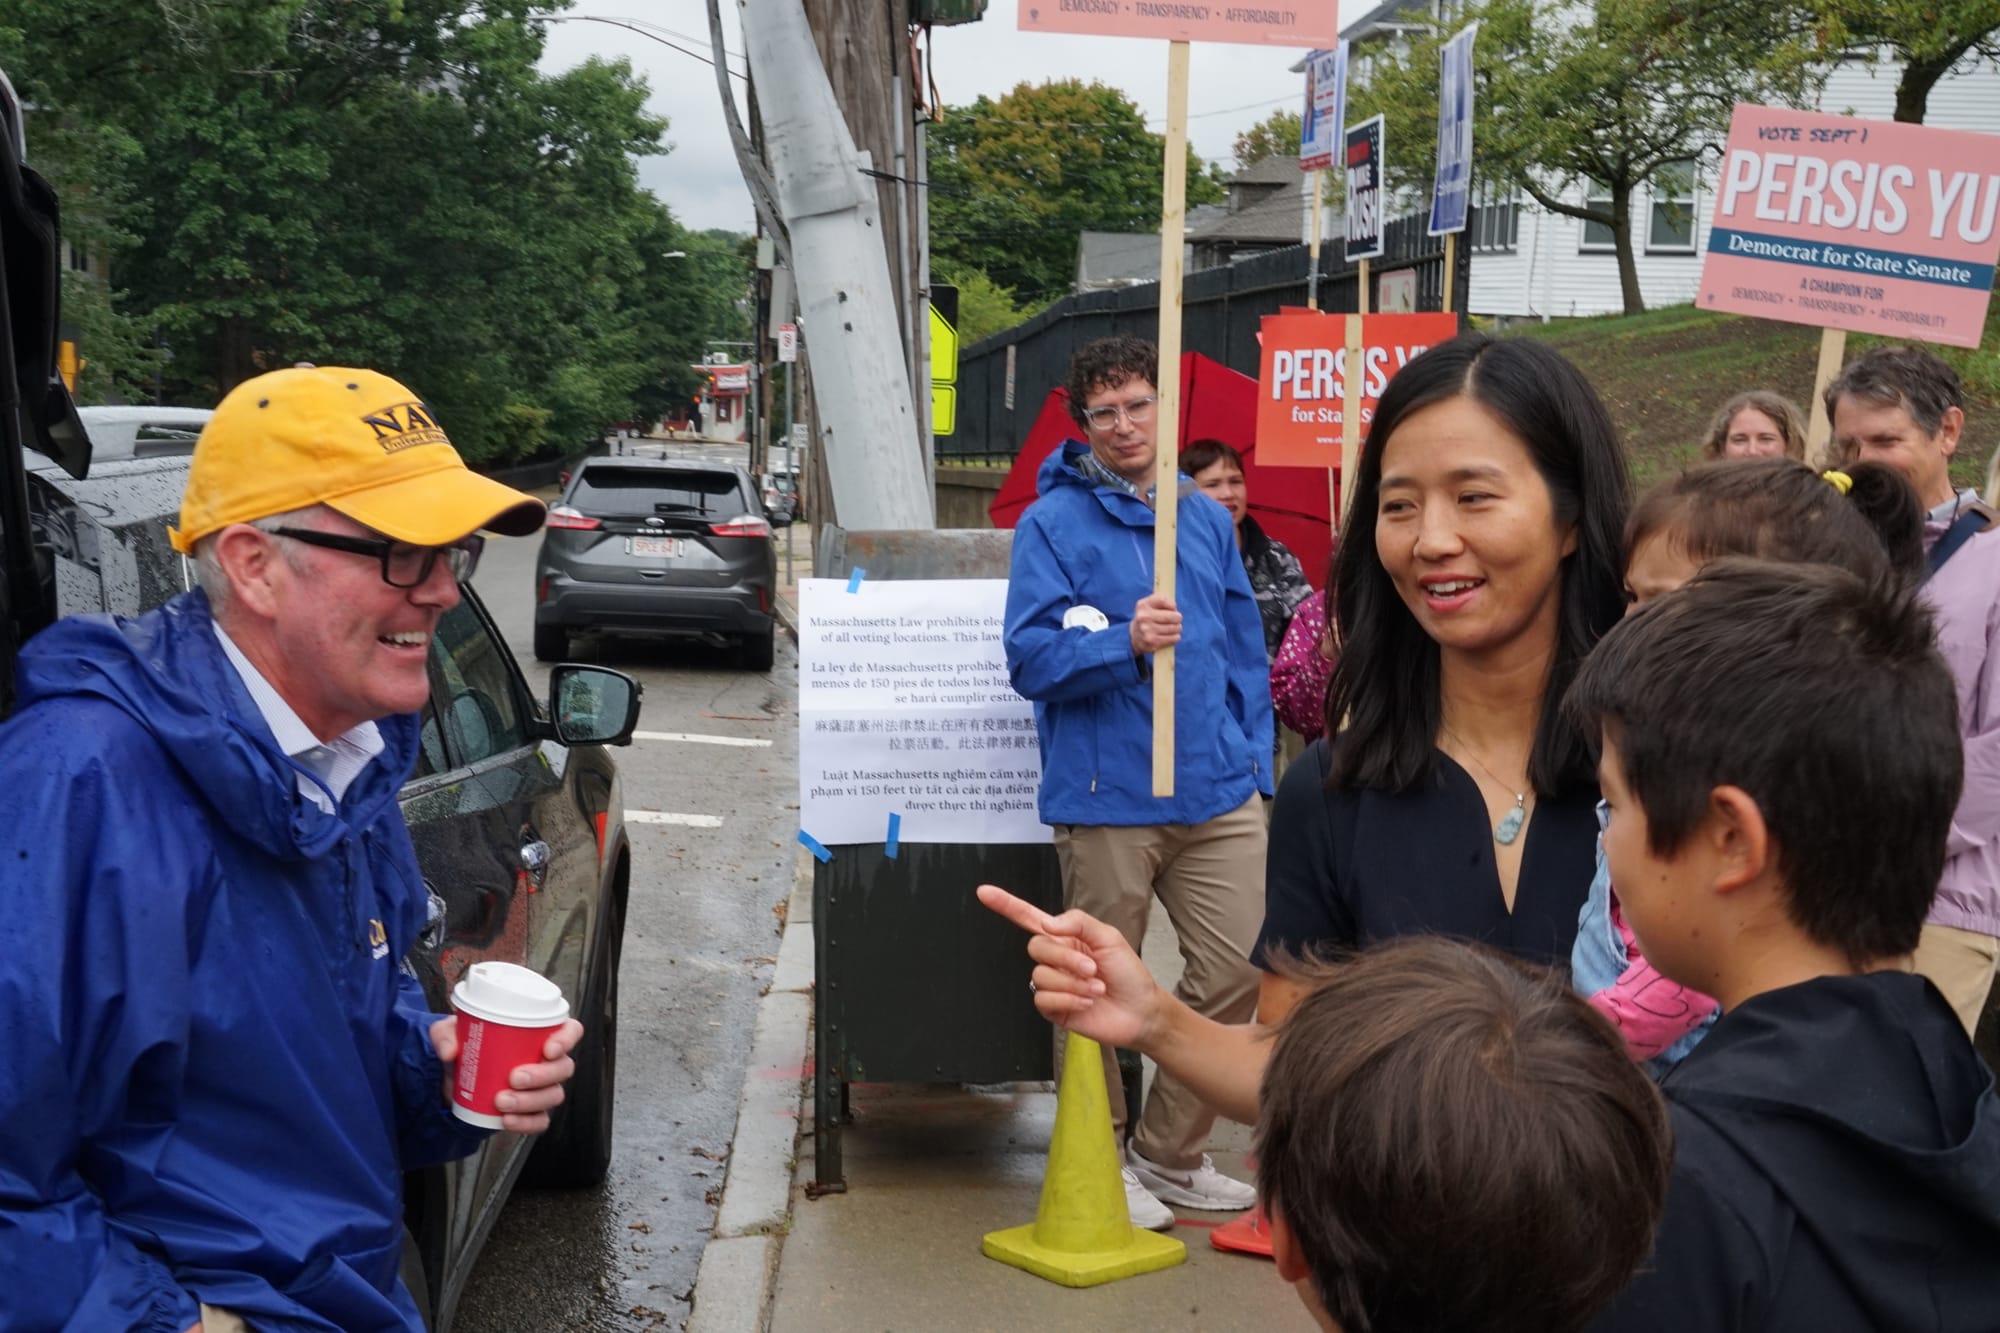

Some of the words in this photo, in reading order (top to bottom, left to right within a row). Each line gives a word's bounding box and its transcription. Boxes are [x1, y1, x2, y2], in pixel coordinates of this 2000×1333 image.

[1059, 0, 1119, 14] DEMOCRACY
[1136, 2, 1211, 21] TRANSPARENCY
[1225, 9, 1297, 25] AFFORDABILITY
[1758, 126, 1802, 141] VOTE
[1810, 128, 1857, 143] SEPT
[1721, 149, 1915, 235] PERSIS
[1928, 168, 2000, 243] YU
[1728, 233, 1819, 264] Democrat
[1823, 247, 1852, 266] for
[1853, 251, 1902, 274] State
[1905, 261, 1972, 283] Senate
[1800, 277, 1808, 290] A
[1809, 279, 1862, 298] CHAMPION
[1864, 287, 1884, 301] FOR
[1731, 287, 1784, 304] DEMOCRACY
[1798, 296, 1866, 316] TRANSPARENCY
[1879, 308, 1946, 328] AFFORDABILITY
[1291, 406, 1316, 423] for
[1317, 407, 1344, 424] Sta
[809, 616, 897, 627] Massachusetts
[899, 616, 921, 627] Law
[926, 616, 981, 630] prohibits
[820, 632, 833, 643] of
[835, 632, 850, 643] all
[853, 632, 891, 646] voting
[952, 632, 979, 643] This
[981, 632, 1001, 642] law
[811, 662, 826, 673] La
[828, 662, 846, 676] ley
[848, 662, 863, 673] de
[866, 661, 954, 673] Massachusetts
[811, 679, 851, 689] menos
[853, 678, 868, 689] de
[870, 678, 890, 689] 150
[892, 678, 918, 692] pies
[920, 678, 934, 688] de
[937, 677, 971, 688] todos
[972, 676, 991, 687] los
[894, 695, 908, 704] se
[940, 692, 987, 706] cumplir
[852, 768, 941, 781] Massachusetts
[943, 768, 988, 783] nghiêm
[810, 785, 844, 800] phạm
[846, 785, 858, 796] vi
[860, 785, 881, 796] 150
[883, 785, 906, 796] feet
[961, 784, 982, 795] các
[984, 784, 1003, 797] địa
[969, 799, 987, 810] thi
[989, 798, 1034, 813] nghiêm
